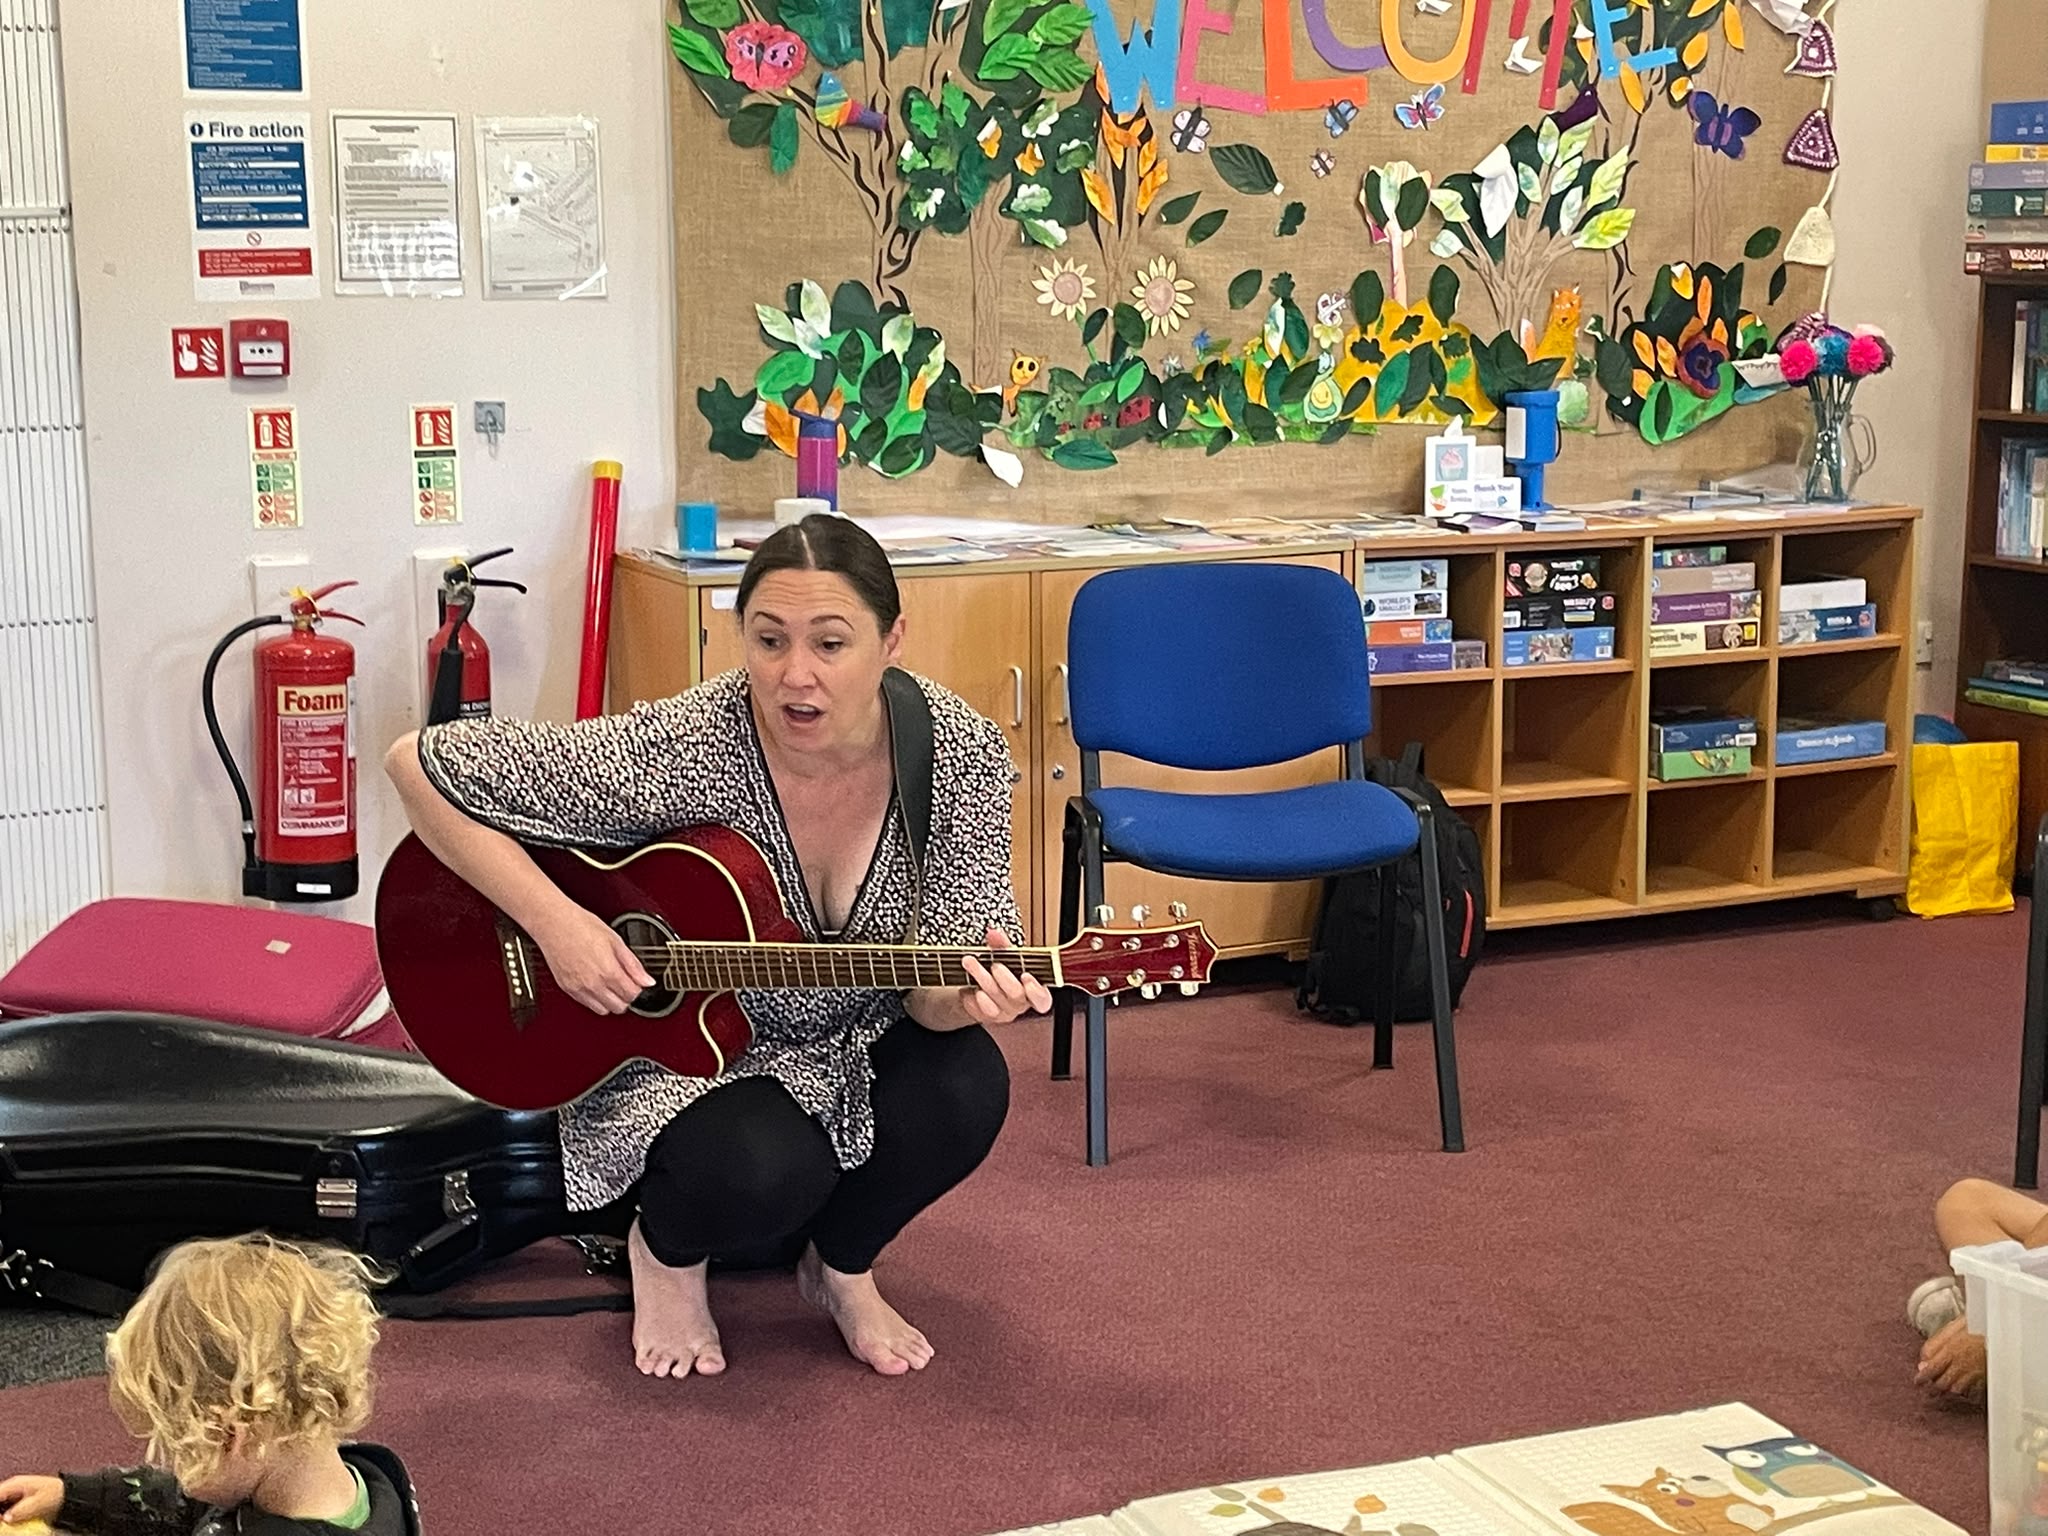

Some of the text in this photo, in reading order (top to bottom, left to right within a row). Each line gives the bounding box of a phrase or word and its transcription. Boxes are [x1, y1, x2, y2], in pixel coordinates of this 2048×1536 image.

[209, 121, 304, 138] Fire action
[284, 689, 344, 712] Foam
